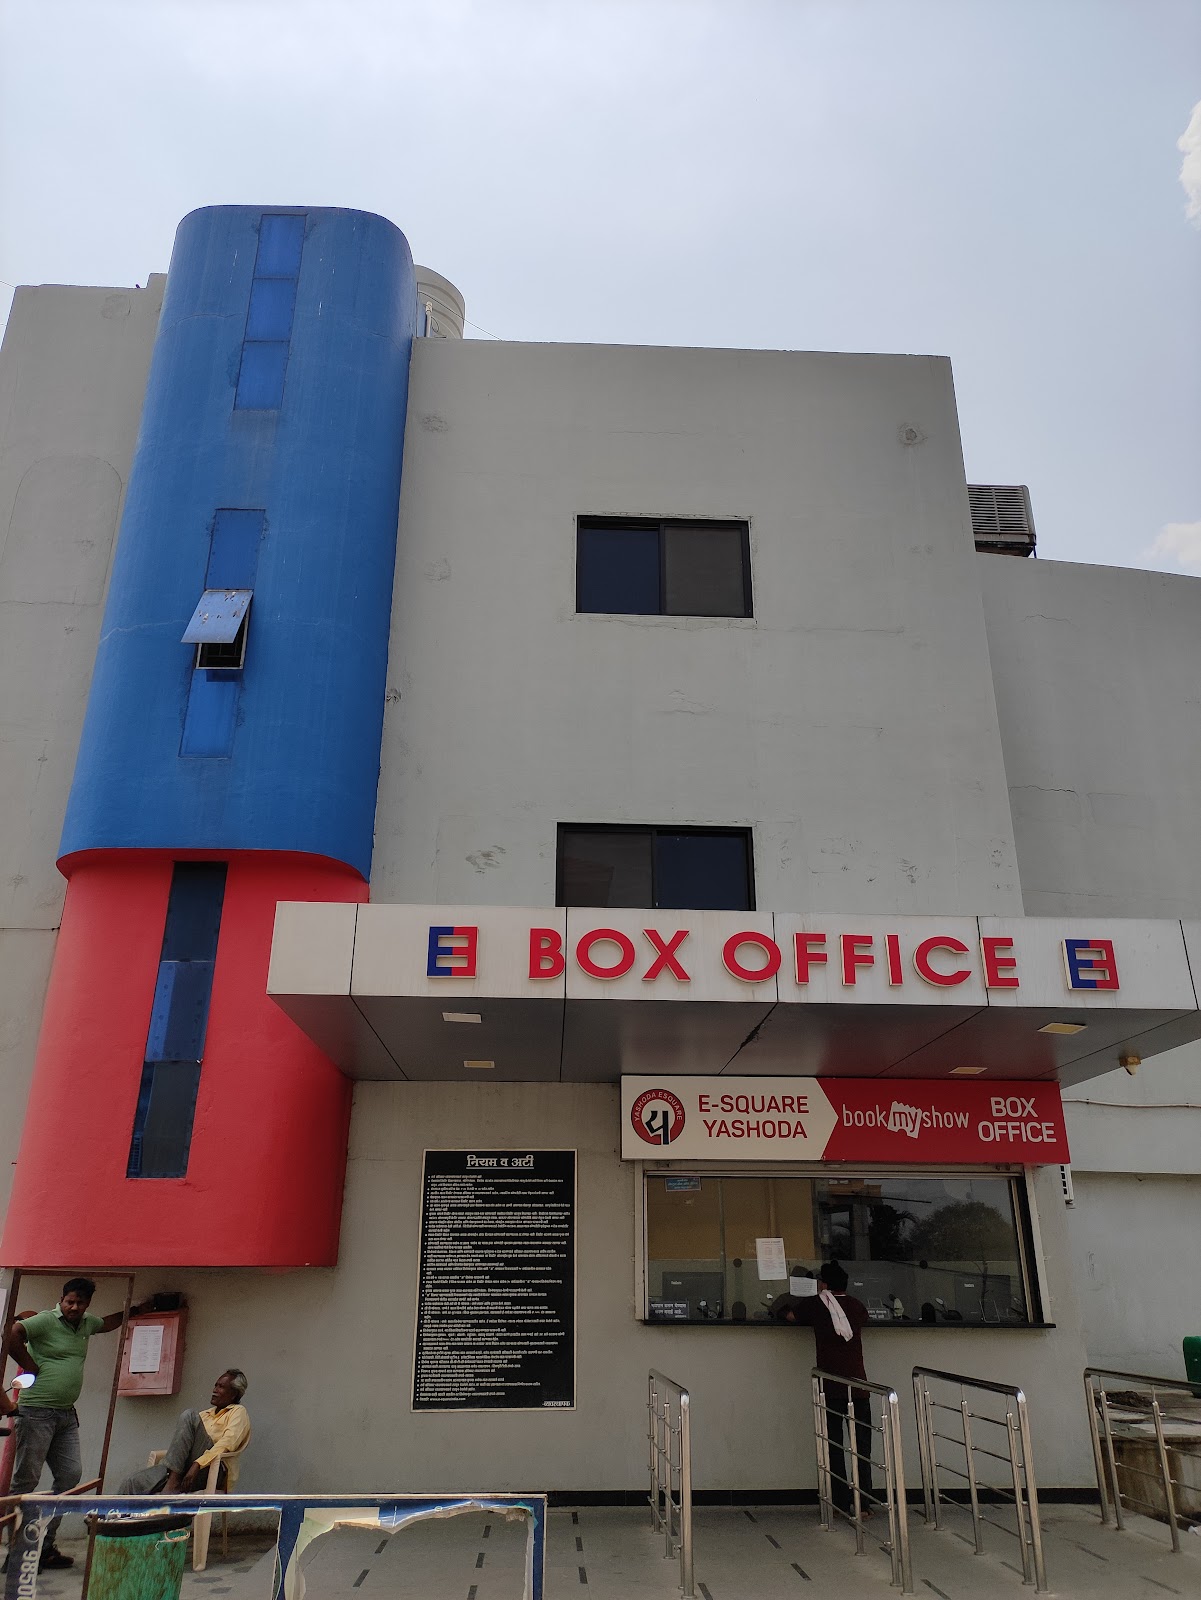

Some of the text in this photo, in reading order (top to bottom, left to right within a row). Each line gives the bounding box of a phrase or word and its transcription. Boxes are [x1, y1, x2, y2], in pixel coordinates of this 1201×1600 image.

[529, 927, 1020, 989] BOX OFFICE
[634, 1091, 683, 1122] YASHODA ESQUARE
[698, 1094, 810, 1115] E-SQUARE
[990, 1096, 1039, 1118] BOX
[702, 1119, 808, 1139] YASHODA
[977, 1120, 1057, 1143] OFFICE
[466, 1154, 535, 1167] नियम व अटी
